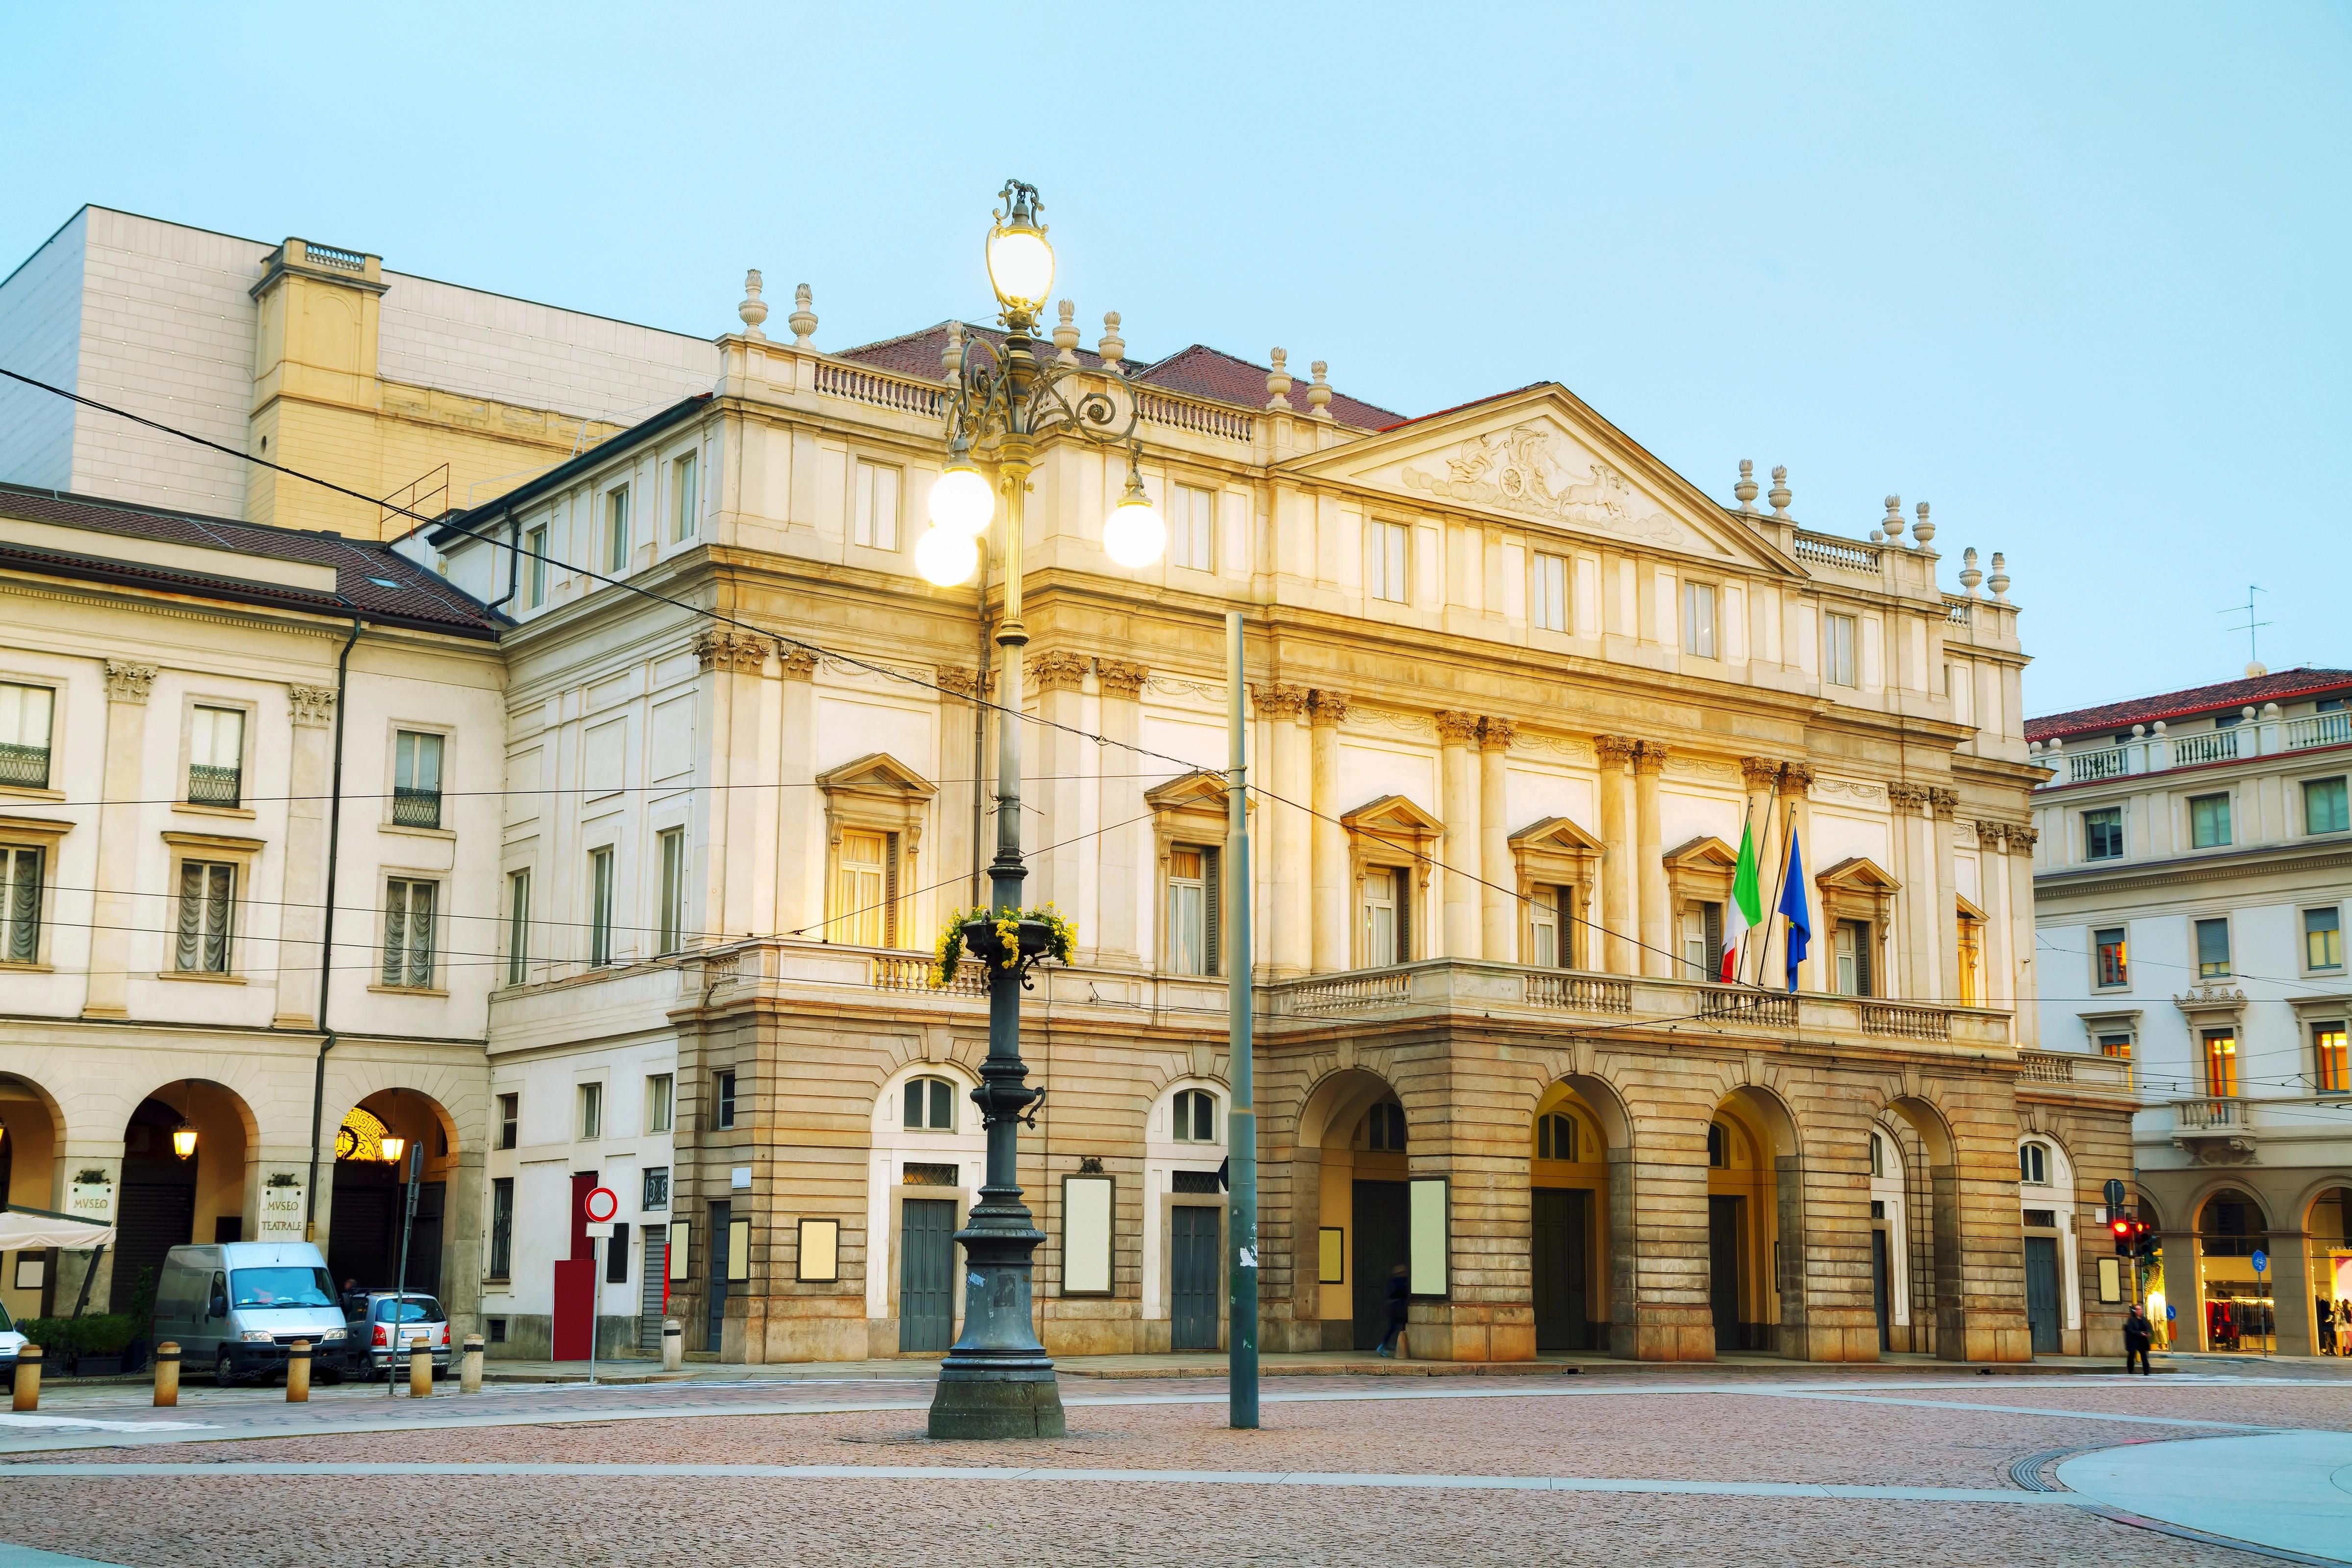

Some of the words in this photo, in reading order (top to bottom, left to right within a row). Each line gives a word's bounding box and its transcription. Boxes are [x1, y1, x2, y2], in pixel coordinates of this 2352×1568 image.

[73, 1199, 108, 1208] MVSEO
[267, 1201, 298, 1210] MVSEO
[261, 1221, 302, 1230] TEATRALE
